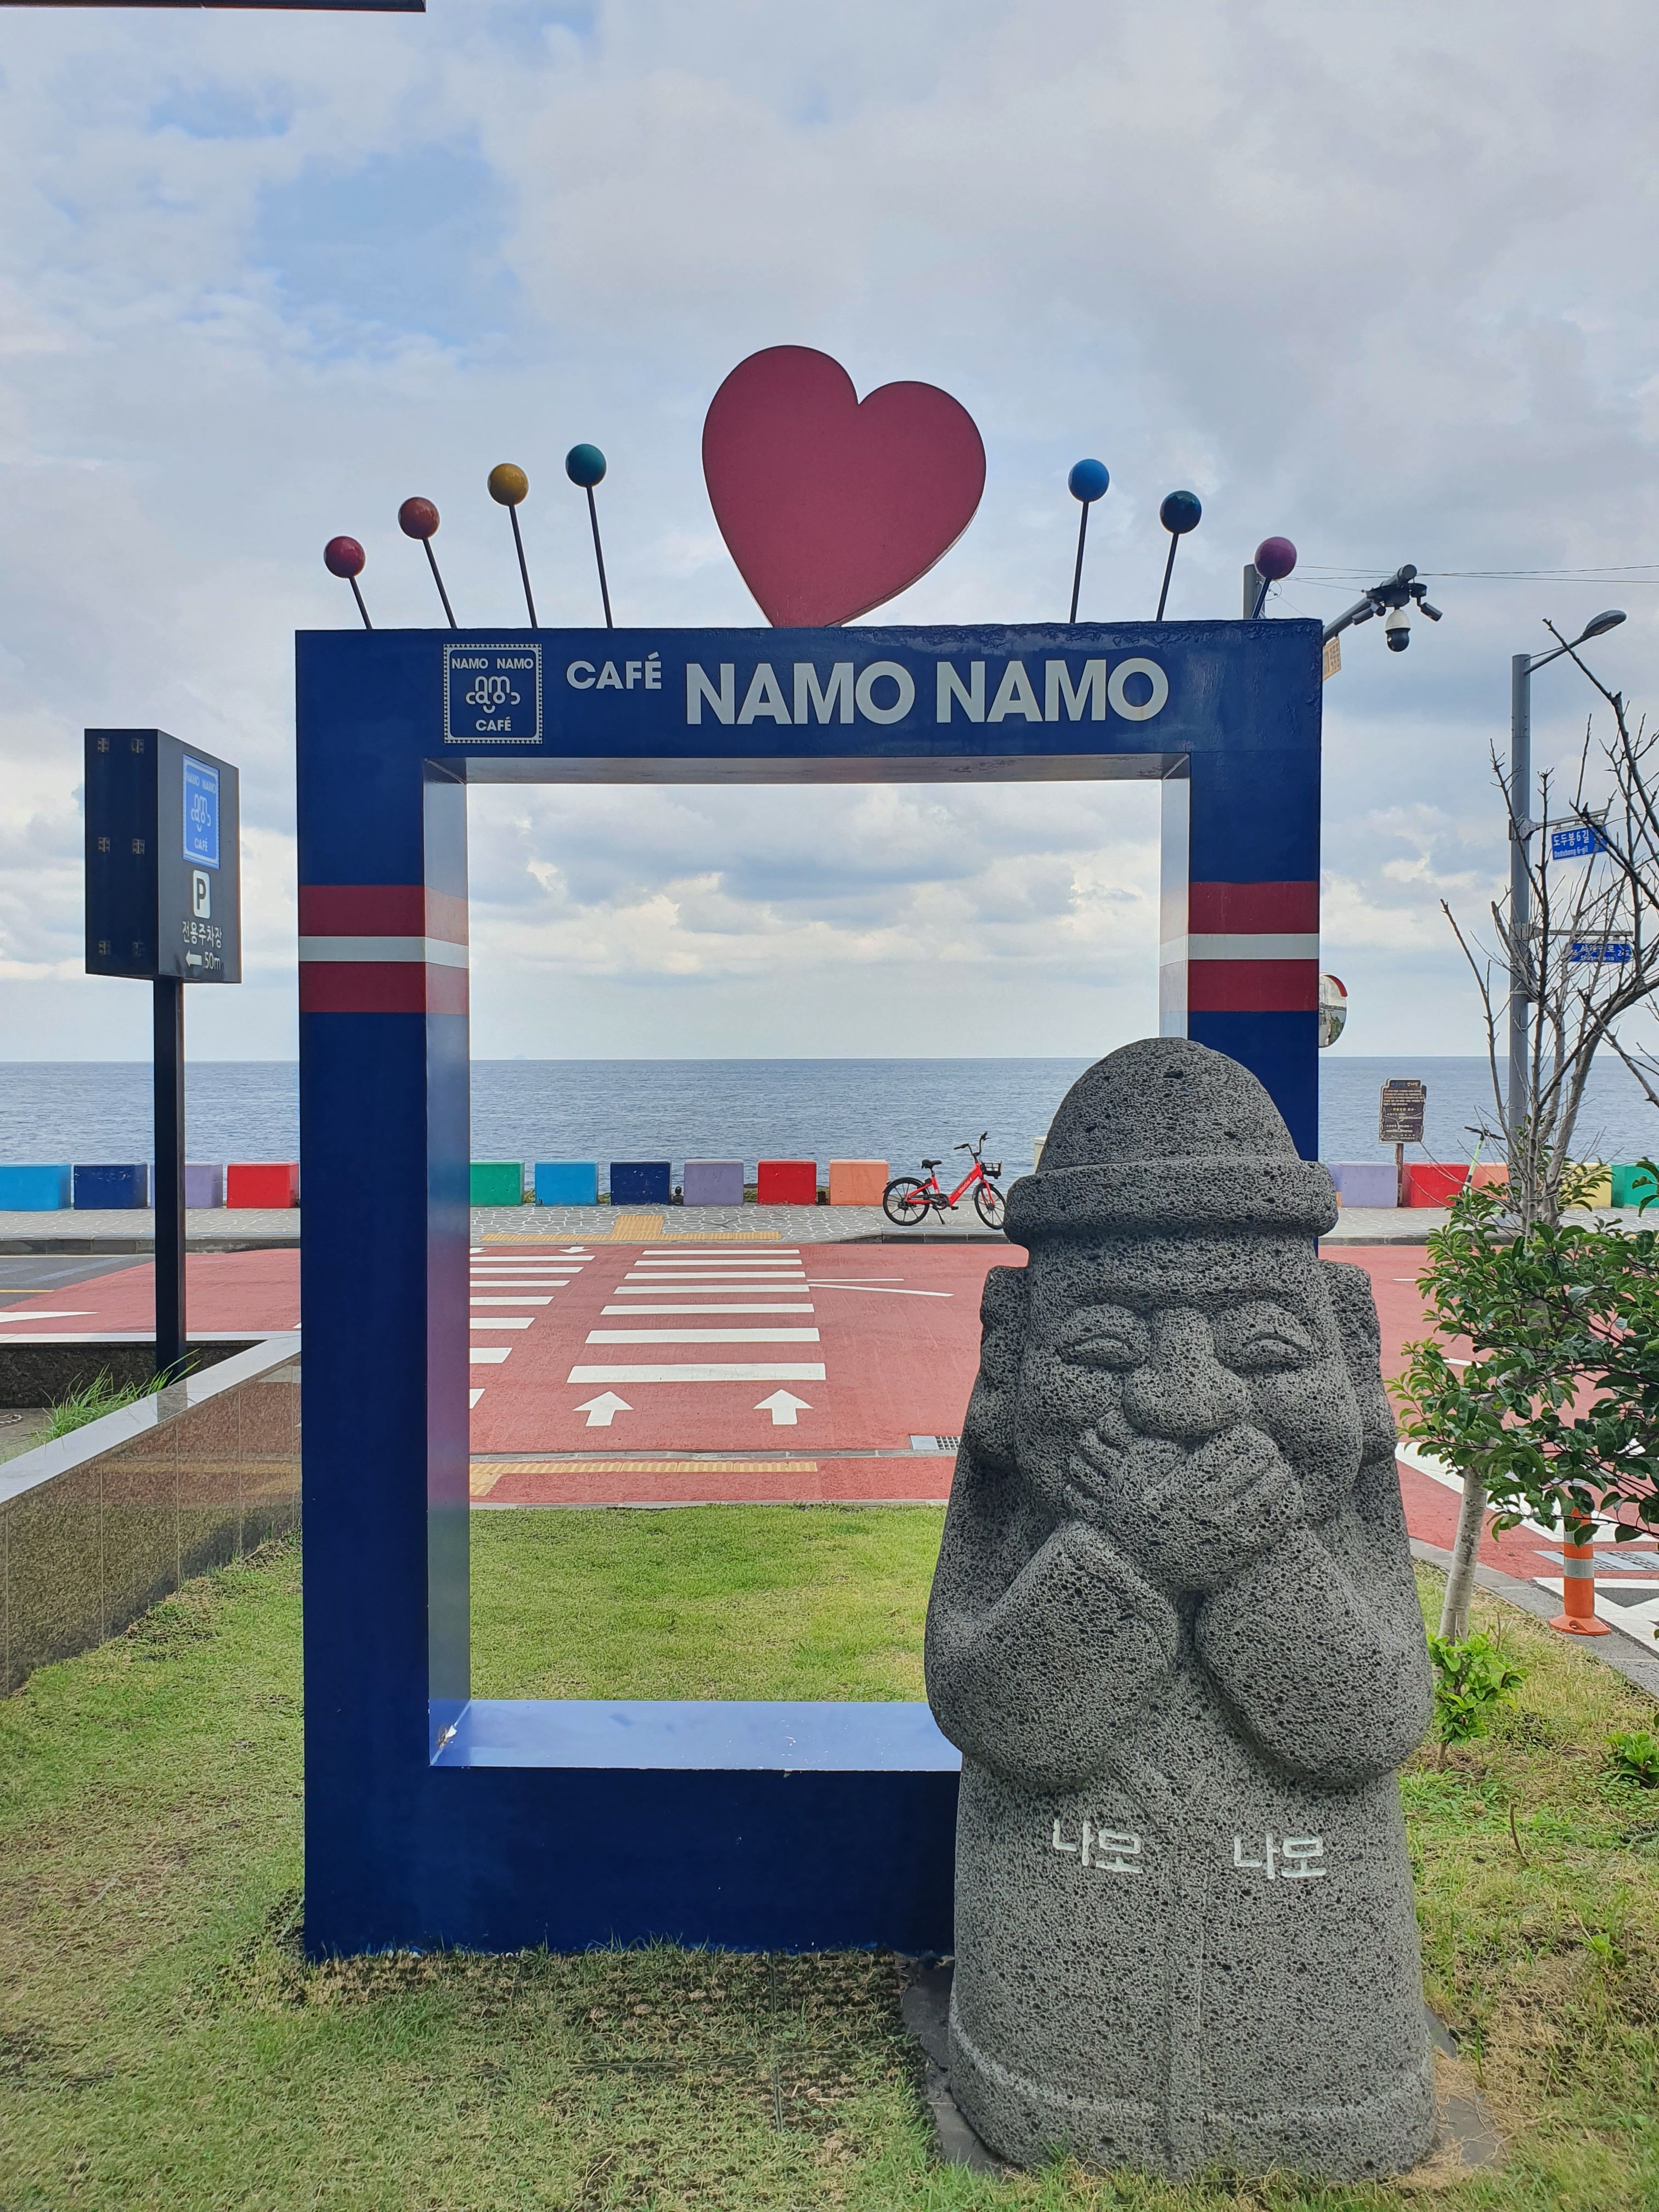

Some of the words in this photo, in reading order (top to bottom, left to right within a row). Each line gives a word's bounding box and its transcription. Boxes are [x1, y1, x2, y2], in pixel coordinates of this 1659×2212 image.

[452, 658, 489, 669] NAMO
[496, 658, 534, 669] NAMO
[566, 651, 662, 690] CAFÉ
[686, 661, 915, 725] NAMO
[936, 658, 1169, 723] NAMO
[475, 716, 512, 731] CAFÉ
[186, 771, 200, 787] NAMO
[202, 779, 216, 794] NAMO
[194, 837, 208, 852] CAFÉ
[196, 877, 207, 910] P
[182, 920, 223, 949] 전용주차장
[204, 951, 221, 970] 50m
[1052, 1819, 1143, 1874] 나모
[1233, 1832, 1327, 1880] 나모
